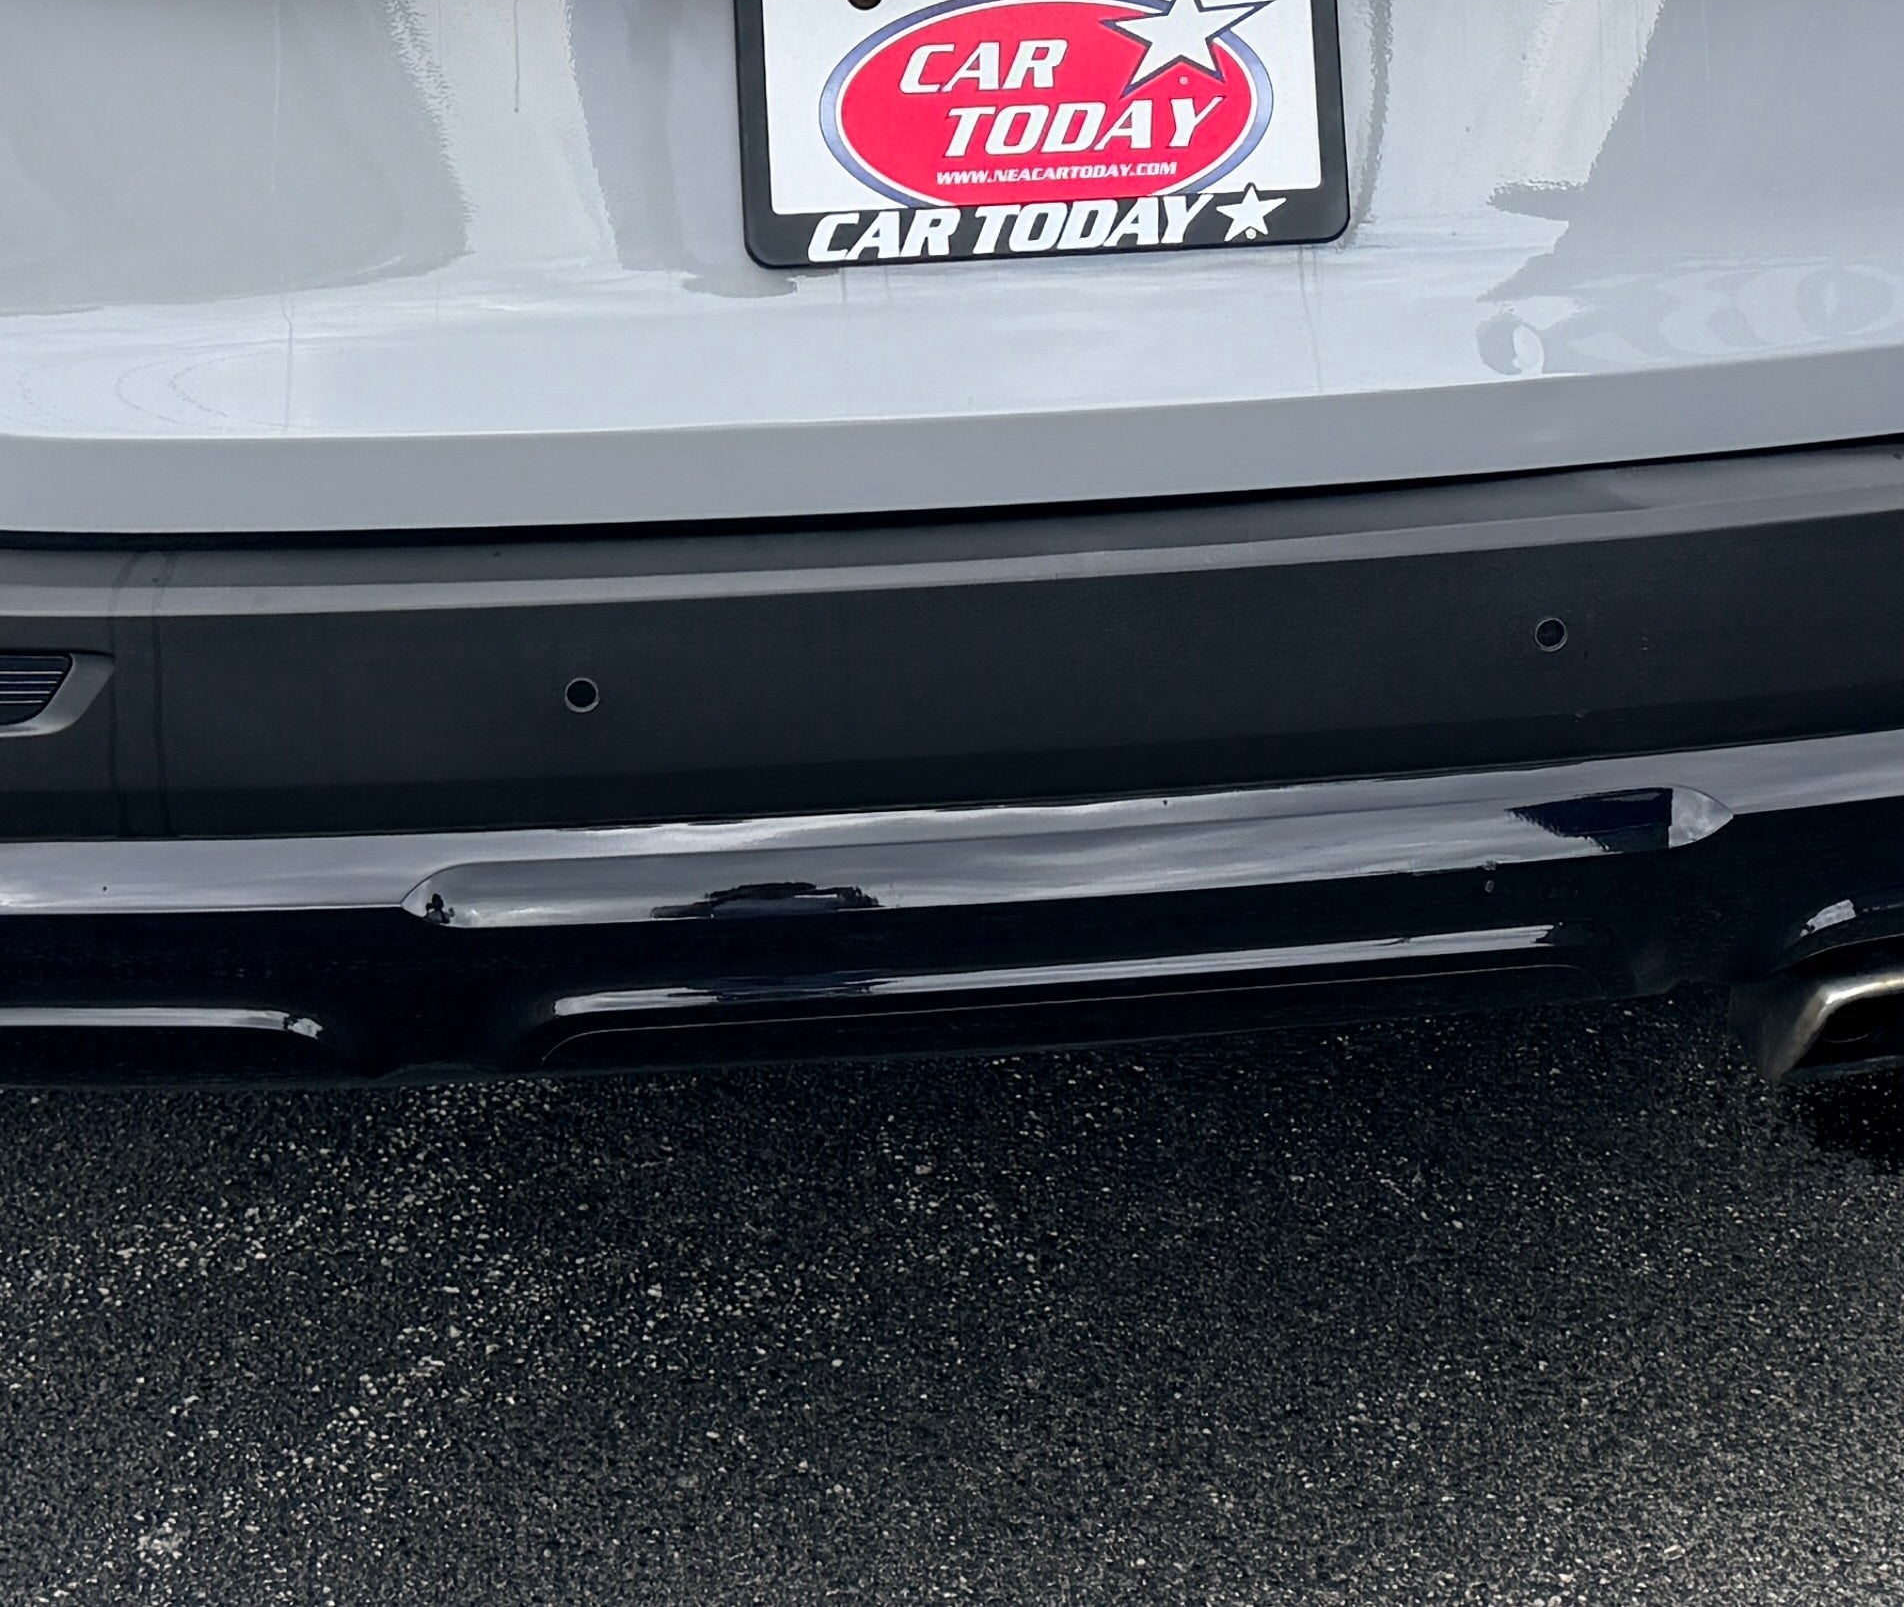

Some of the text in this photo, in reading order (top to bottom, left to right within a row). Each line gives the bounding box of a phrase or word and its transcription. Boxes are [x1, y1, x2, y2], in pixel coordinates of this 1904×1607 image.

[899, 39, 1069, 94] CAR
[944, 96, 1226, 158] TODAY
[936, 161, 1178, 186] WWW.NEACARTODAY.COM
[807, 193, 1214, 263] CAR TODAY
